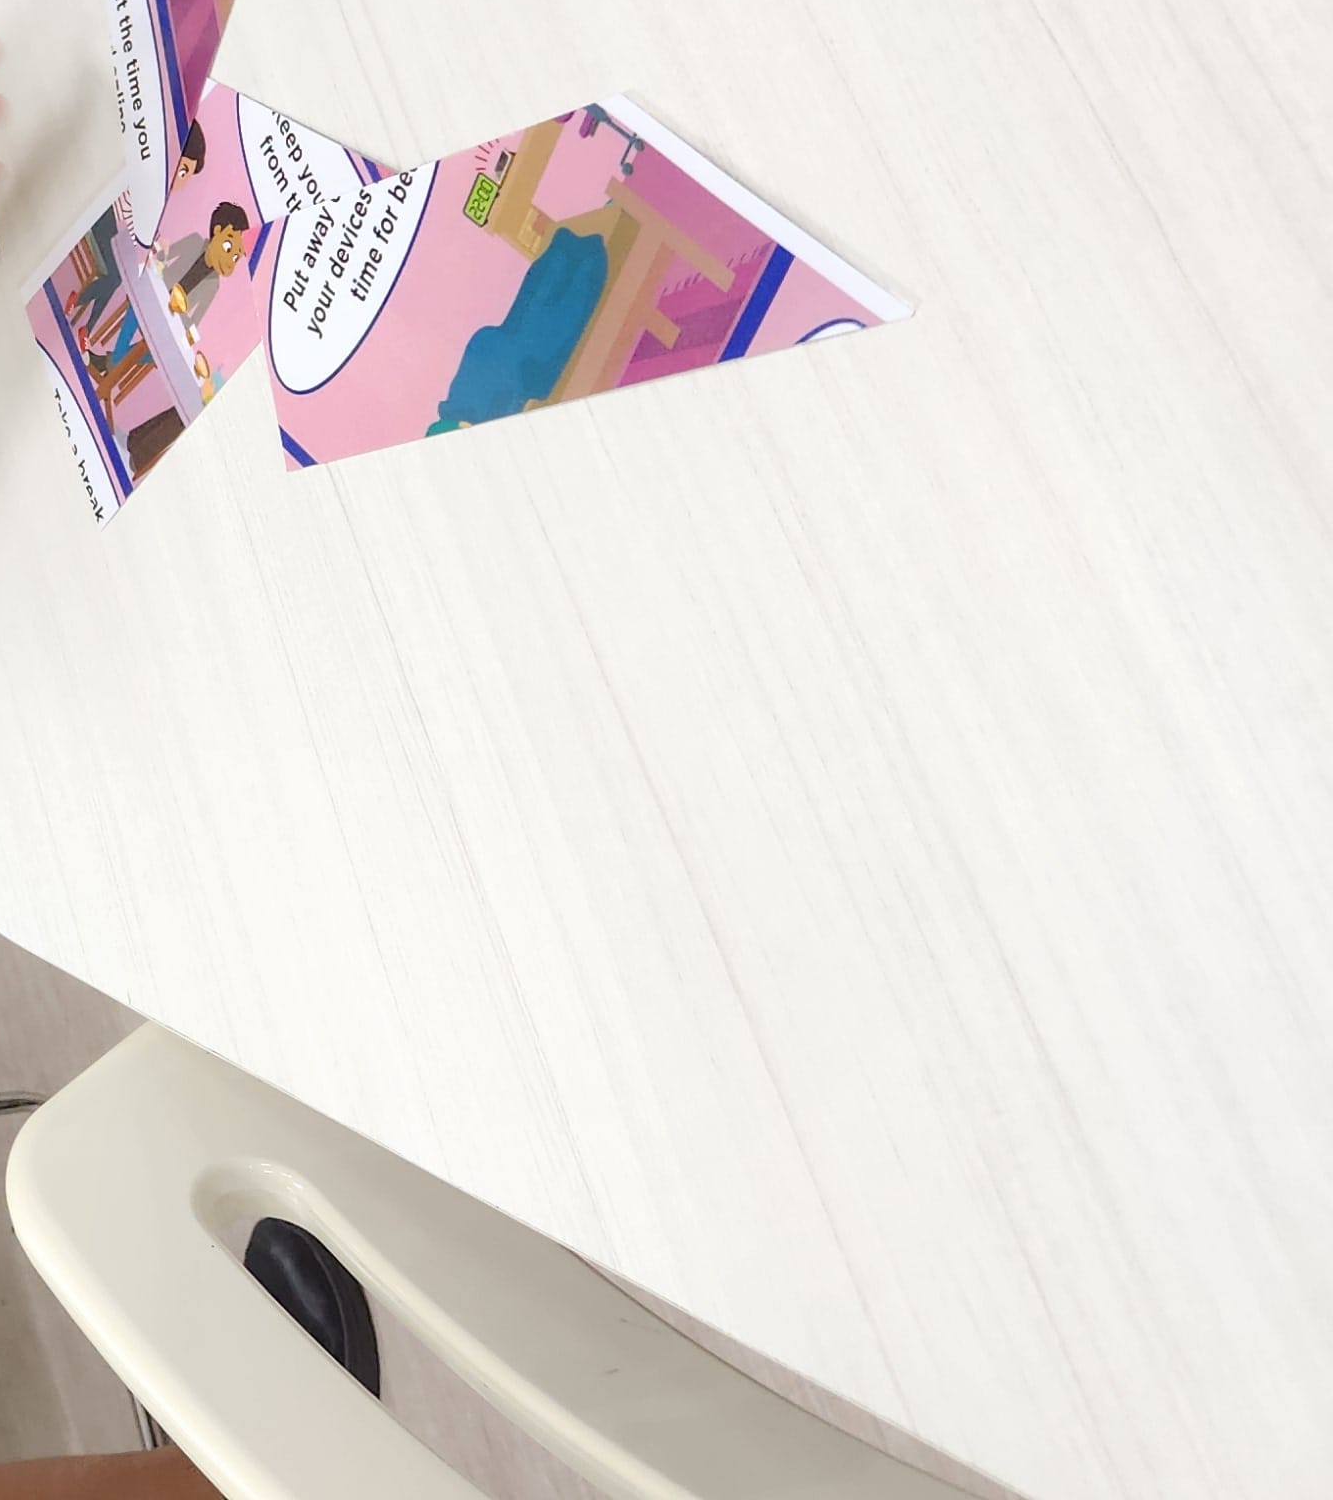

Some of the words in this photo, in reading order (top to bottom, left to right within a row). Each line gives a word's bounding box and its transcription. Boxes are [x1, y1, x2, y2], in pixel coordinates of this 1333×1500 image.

[117, 14, 133, 53] the
[126, 57, 143, 109] time
[135, 116, 152, 160] you
[260, 135, 289, 192] from
[468, 178, 493, 221] 22:00
[282, 269, 310, 313] Put
[302, 205, 335, 269] away
[307, 280, 336, 339] your
[328, 188, 373, 279] devices
[349, 247, 383, 302] time
[372, 205, 399, 245] for
